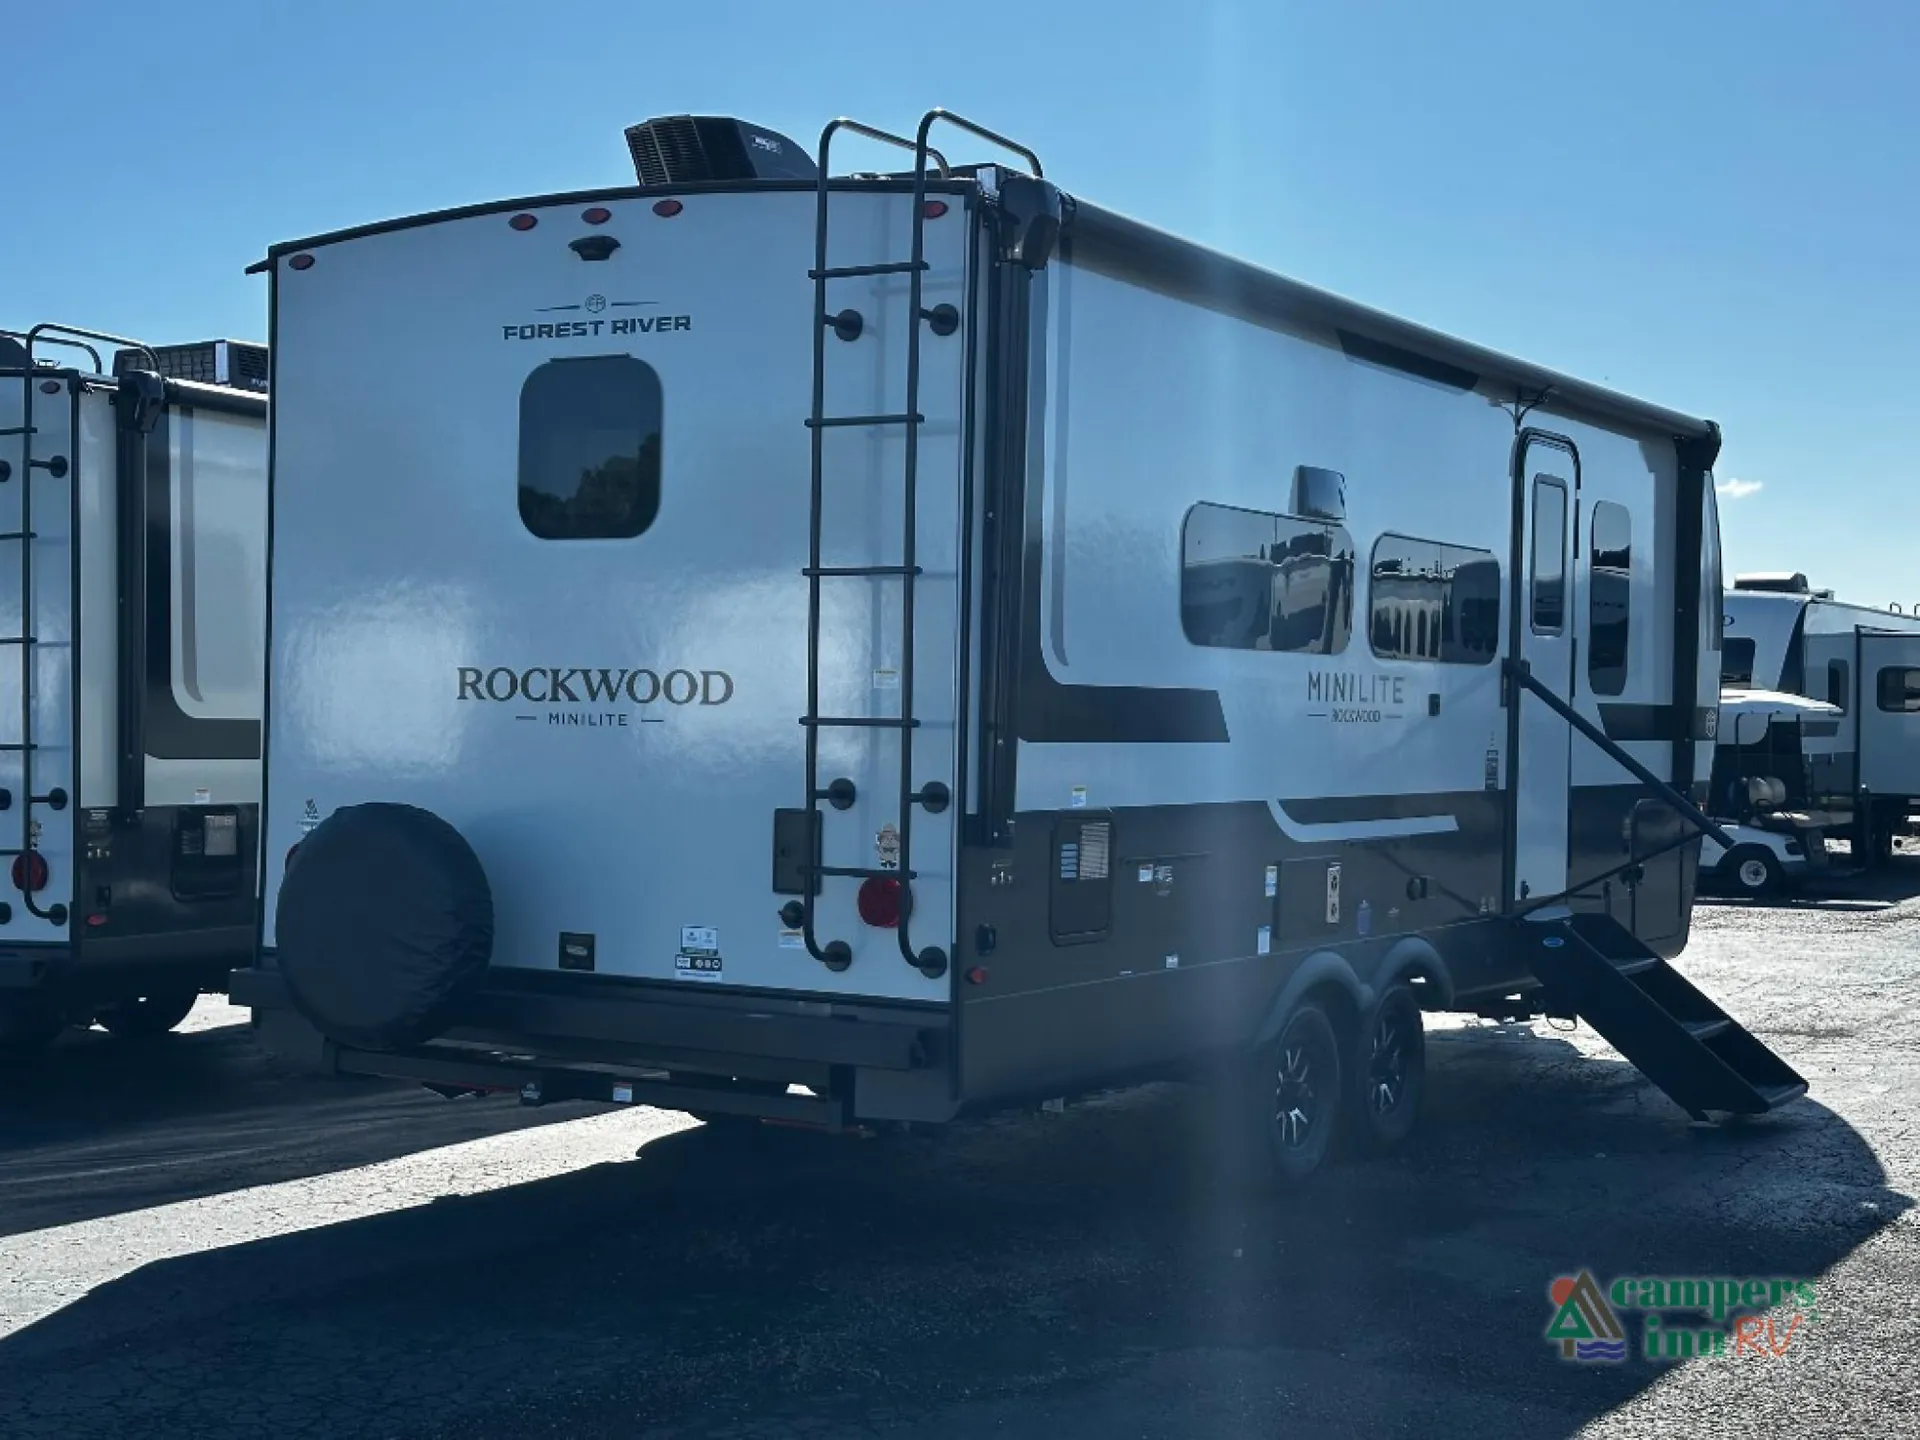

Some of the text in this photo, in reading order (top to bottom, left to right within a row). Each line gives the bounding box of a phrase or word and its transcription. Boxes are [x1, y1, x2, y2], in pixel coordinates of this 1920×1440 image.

[502, 315, 691, 340] FOREST RIVER
[456, 667, 734, 706] ROCKWOOD
[1307, 671, 1405, 704] MINILITE
[548, 713, 628, 727] MINILITE
